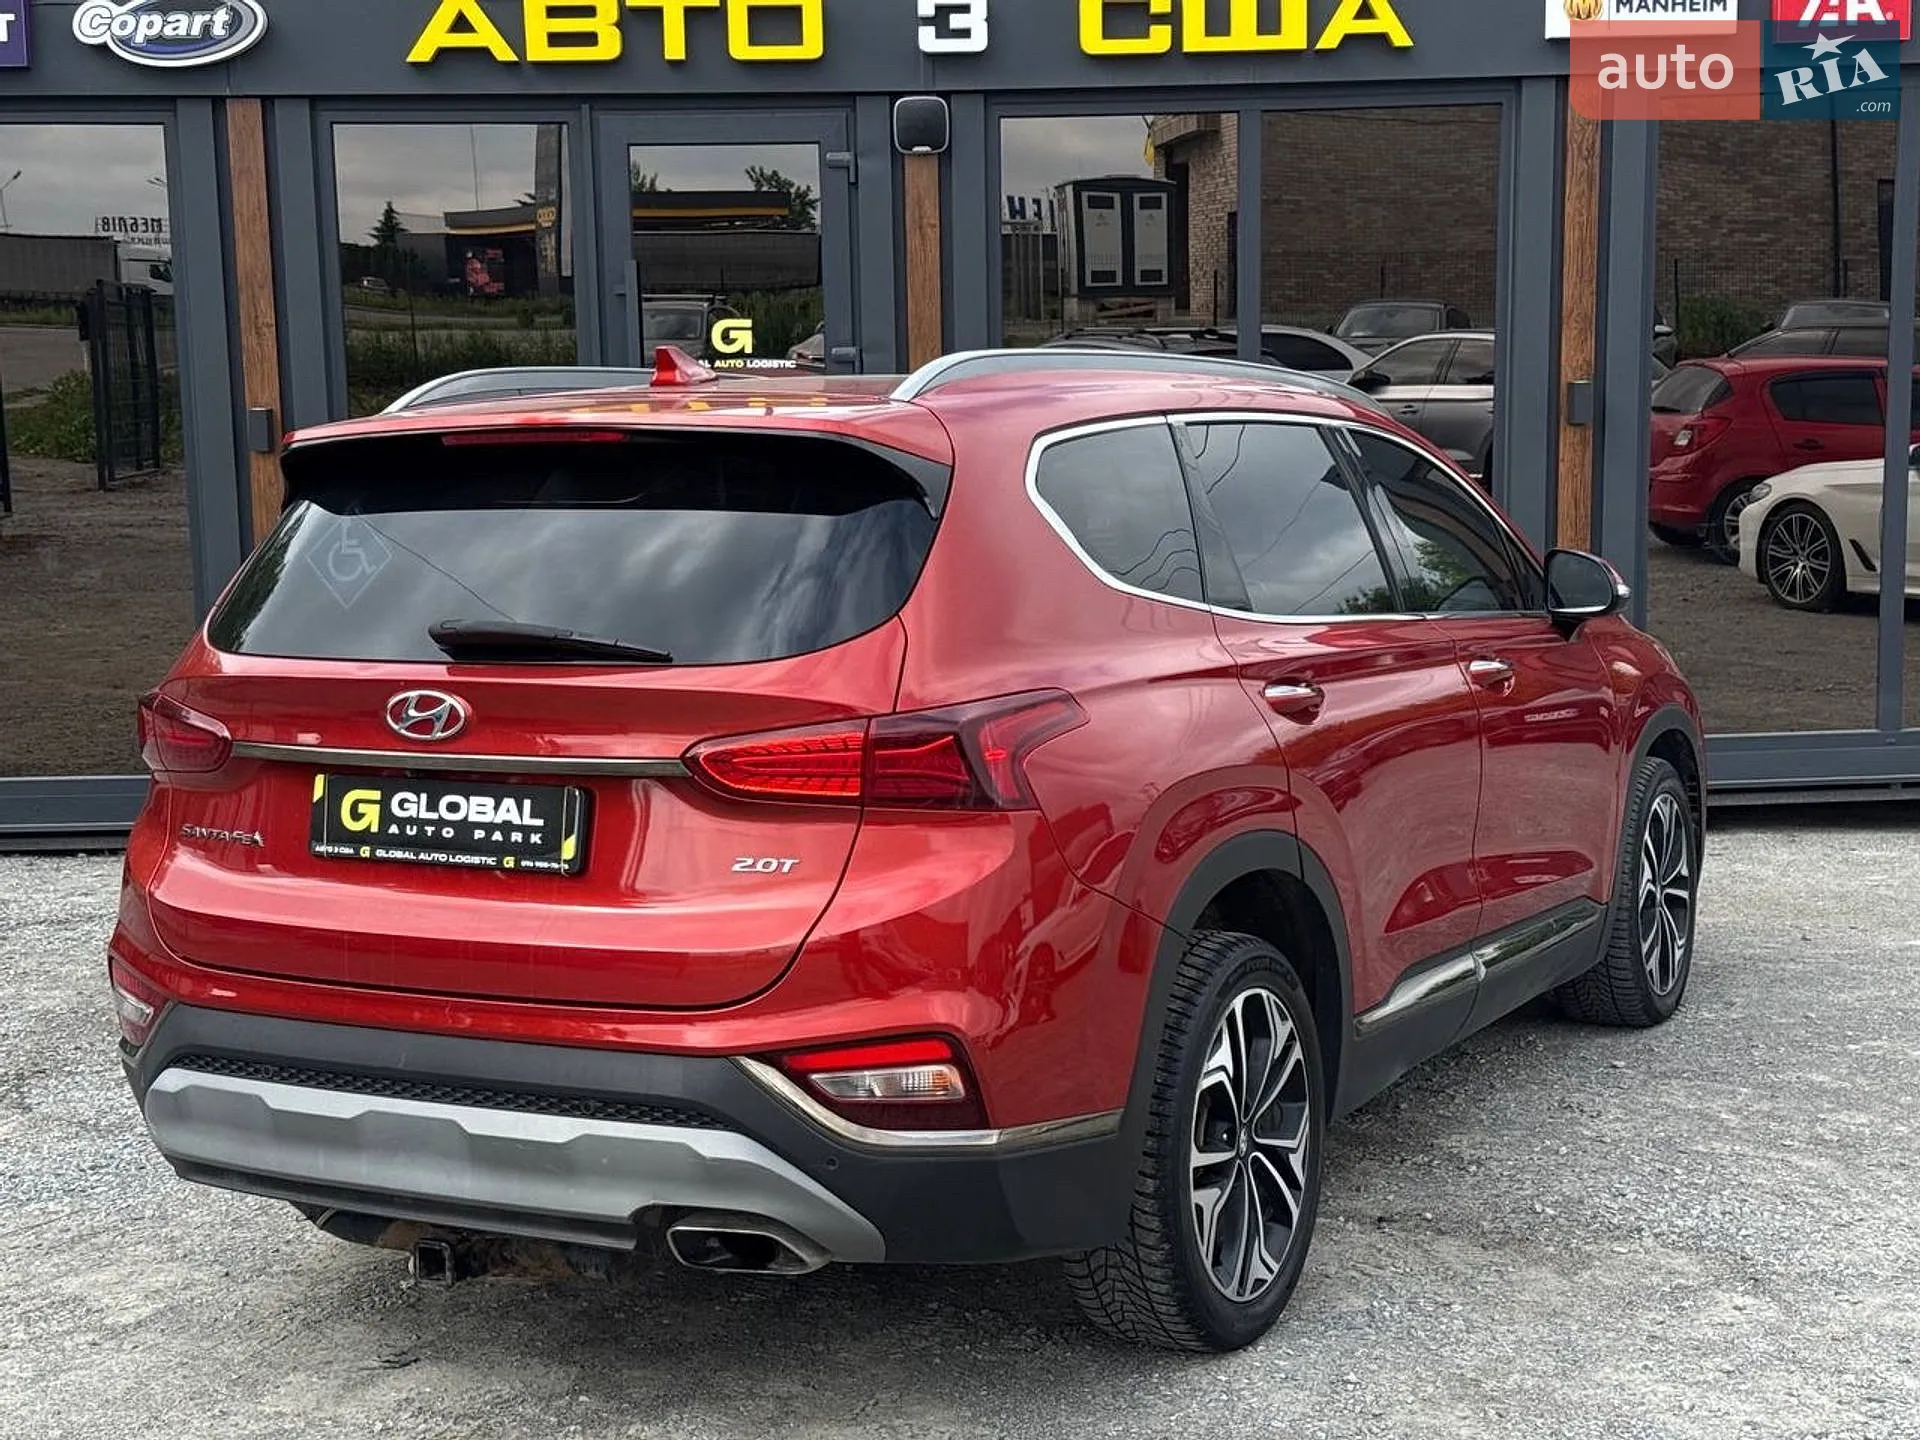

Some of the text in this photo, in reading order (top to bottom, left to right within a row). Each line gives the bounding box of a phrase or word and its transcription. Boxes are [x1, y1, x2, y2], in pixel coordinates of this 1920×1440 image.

[1615, 0, 1728, 13] MANHEIM
[79, 5, 233, 46] Copart
[405, 0, 825, 63] АВТО
[1079, 0, 1415, 55] США
[711, 318, 753, 354] G
[714, 360, 744, 369] AUTO
[745, 360, 797, 369] LOGISTIC
[340, 788, 382, 833] G
[389, 790, 545, 827] GLOBAL
[387, 825, 543, 844] AUTO PARK
[375, 848, 416, 860] GLOBAL
[418, 851, 448, 863] AUTO
[448, 853, 497, 866] LOGISTIC
